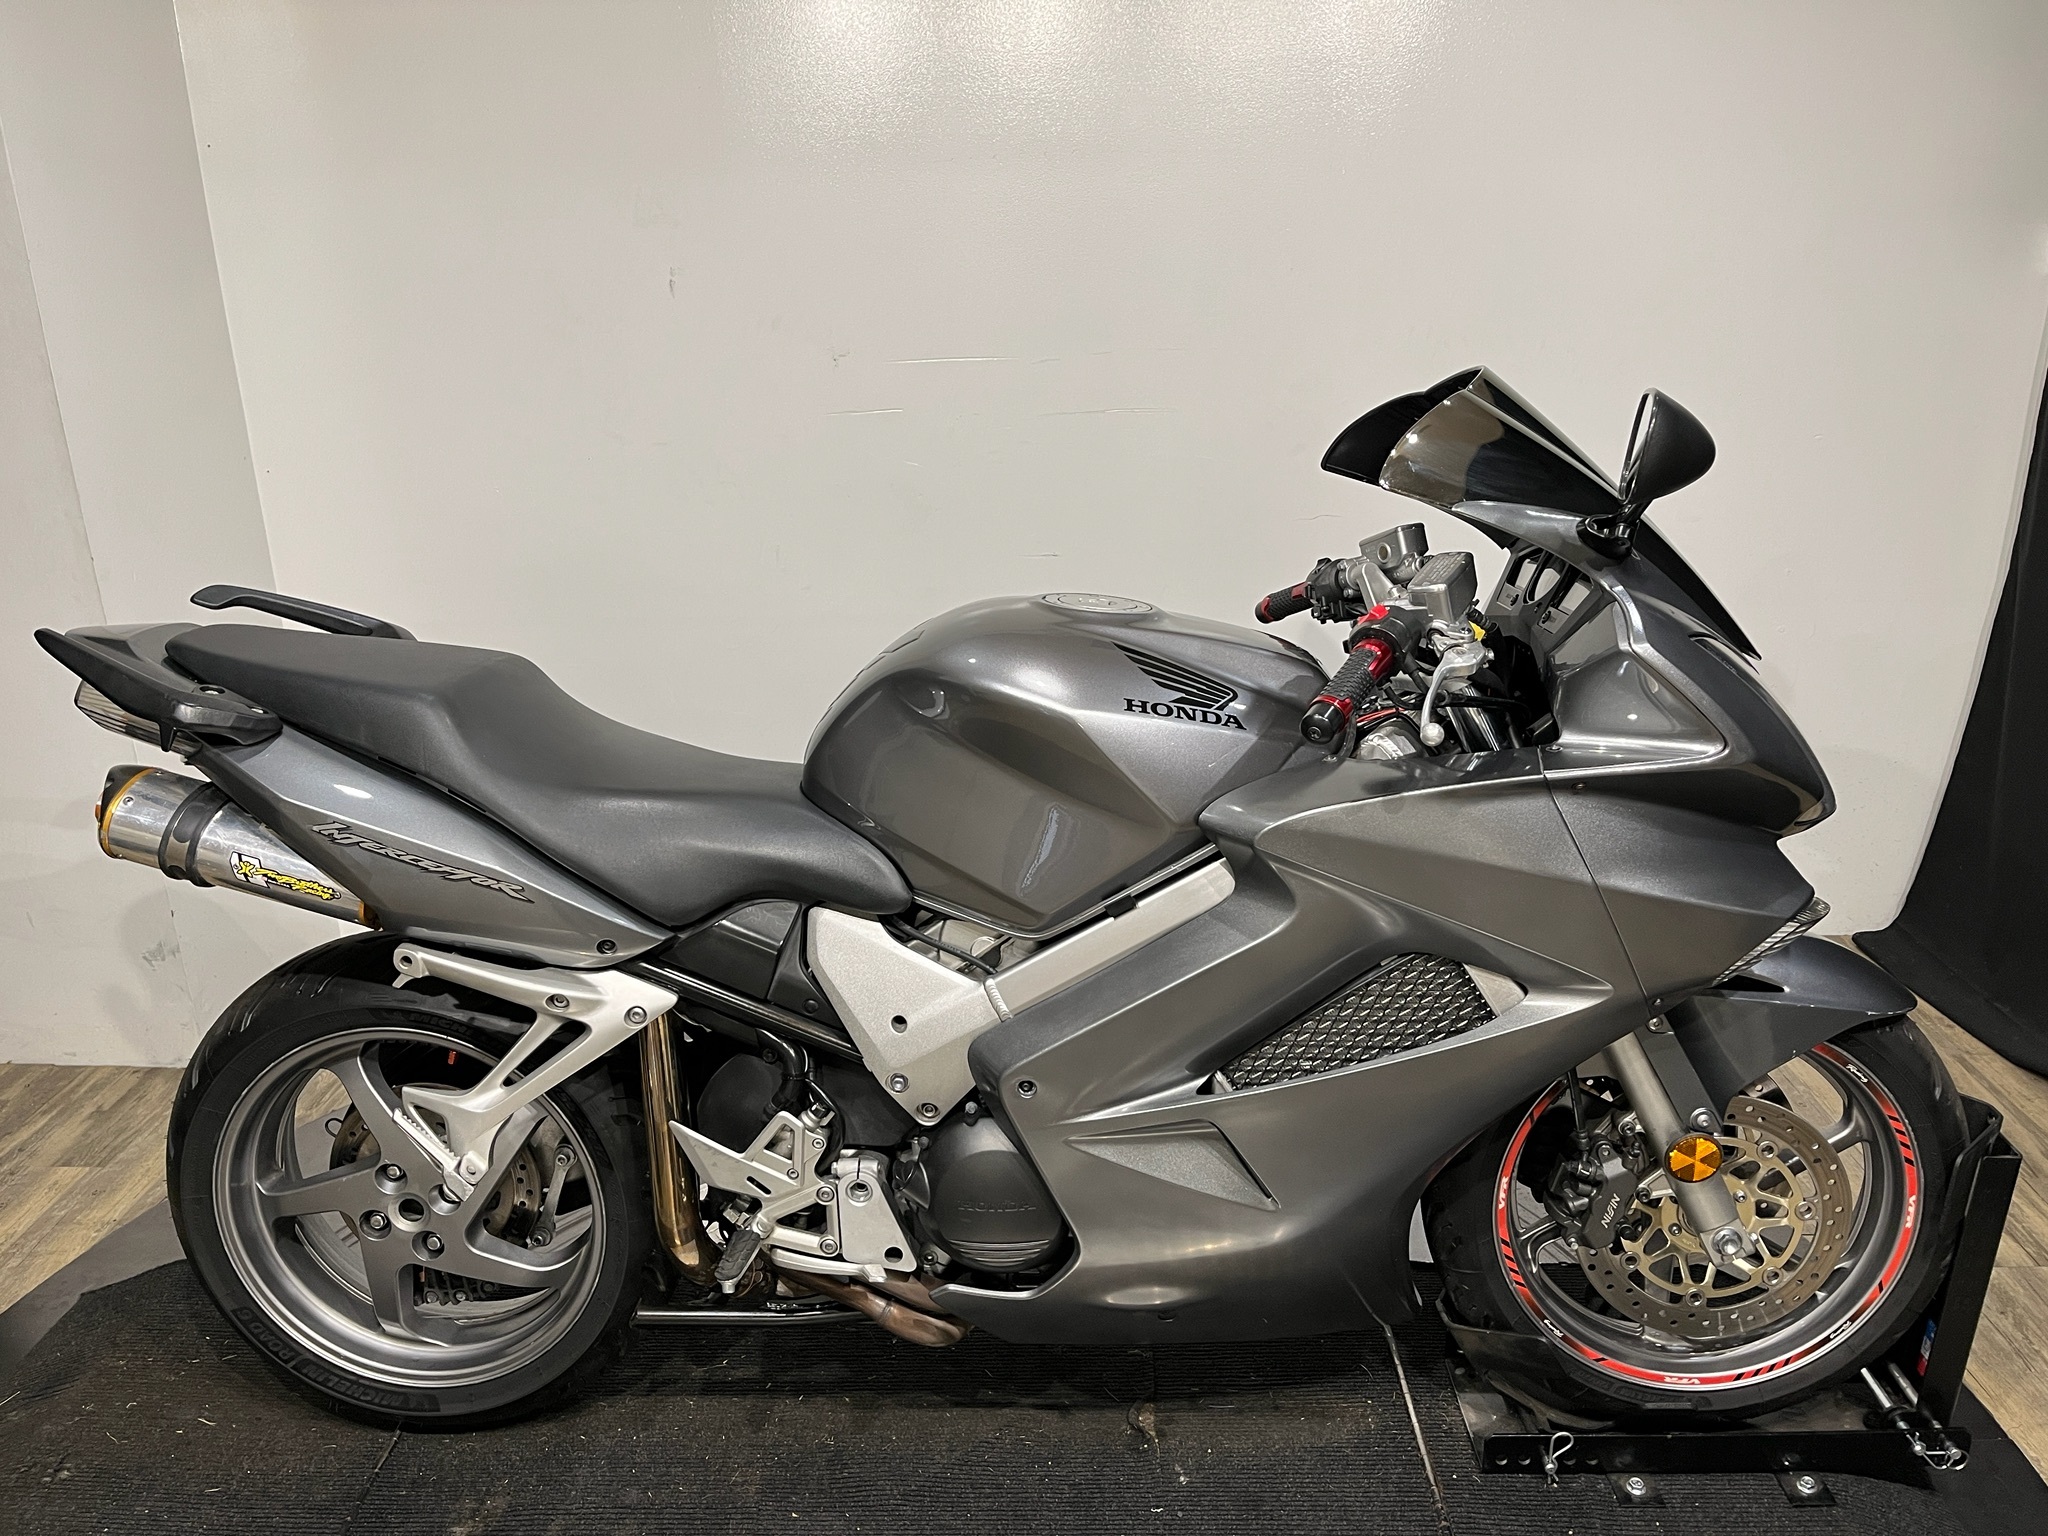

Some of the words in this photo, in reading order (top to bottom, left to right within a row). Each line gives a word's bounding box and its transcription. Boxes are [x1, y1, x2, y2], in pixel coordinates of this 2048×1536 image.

[1123, 698, 1247, 730] HONDA
[1498, 1176, 1510, 1210] VFR
[1905, 1195, 1917, 1229] VFR
[1663, 1376, 1701, 1385] VFR
